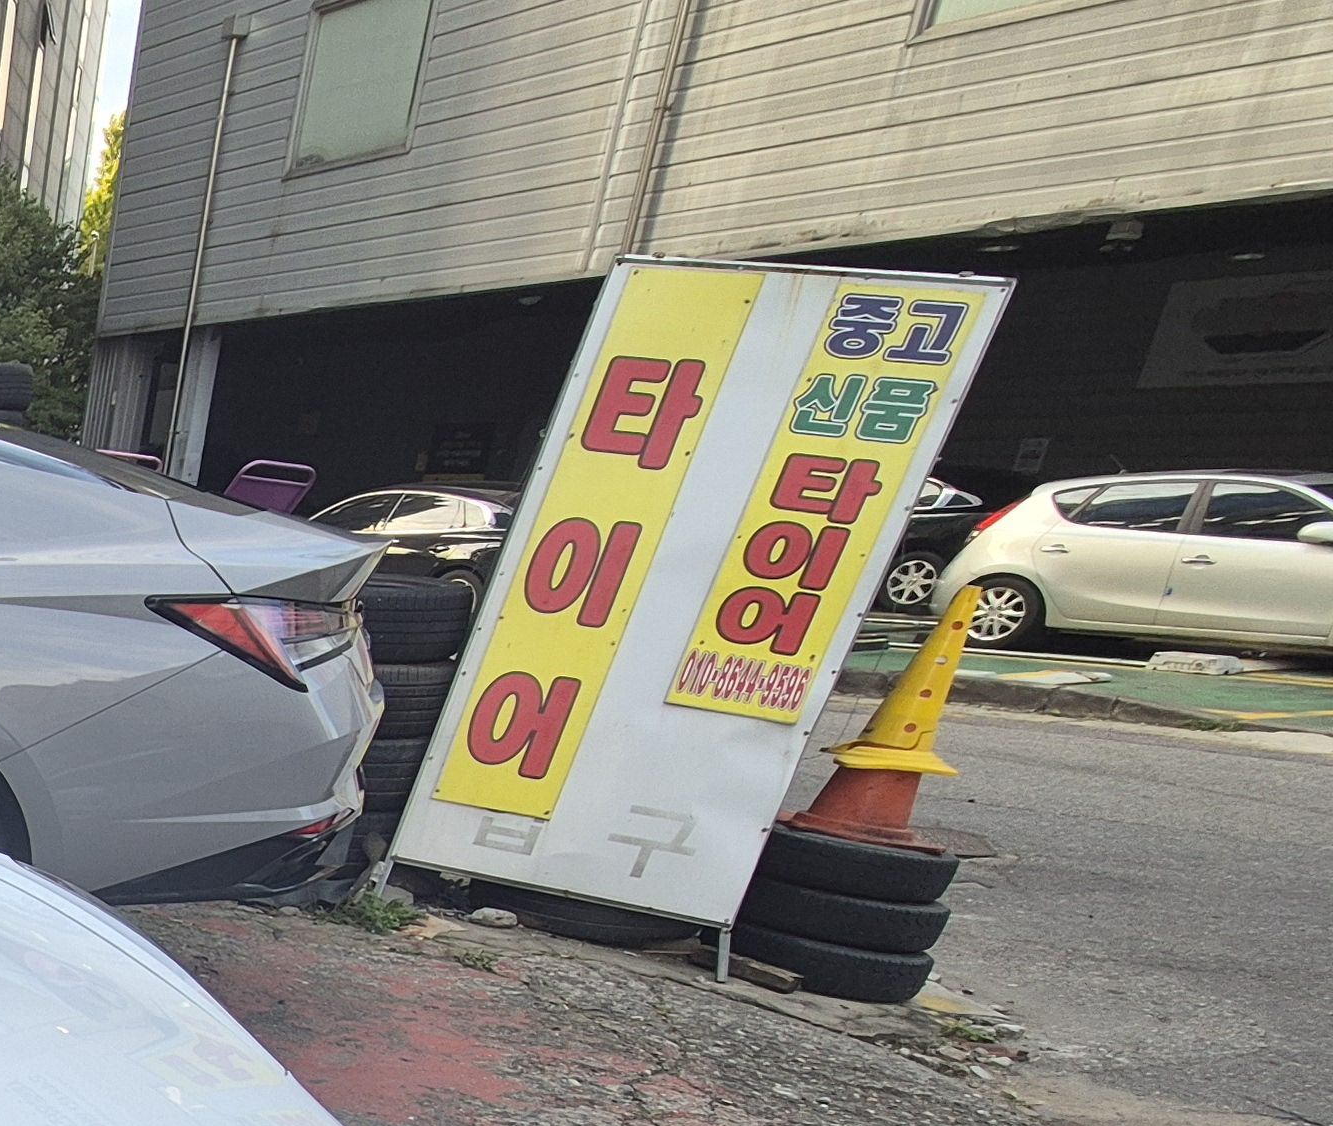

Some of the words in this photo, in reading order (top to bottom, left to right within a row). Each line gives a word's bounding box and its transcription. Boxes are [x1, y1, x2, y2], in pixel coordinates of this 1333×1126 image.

[823, 292, 970, 366] 중고
[789, 373, 938, 444] 신품
[467, 355, 706, 780] 타이어
[715, 453, 883, 655] 타이어
[676, 648, 812, 713] 010-8644-9596
